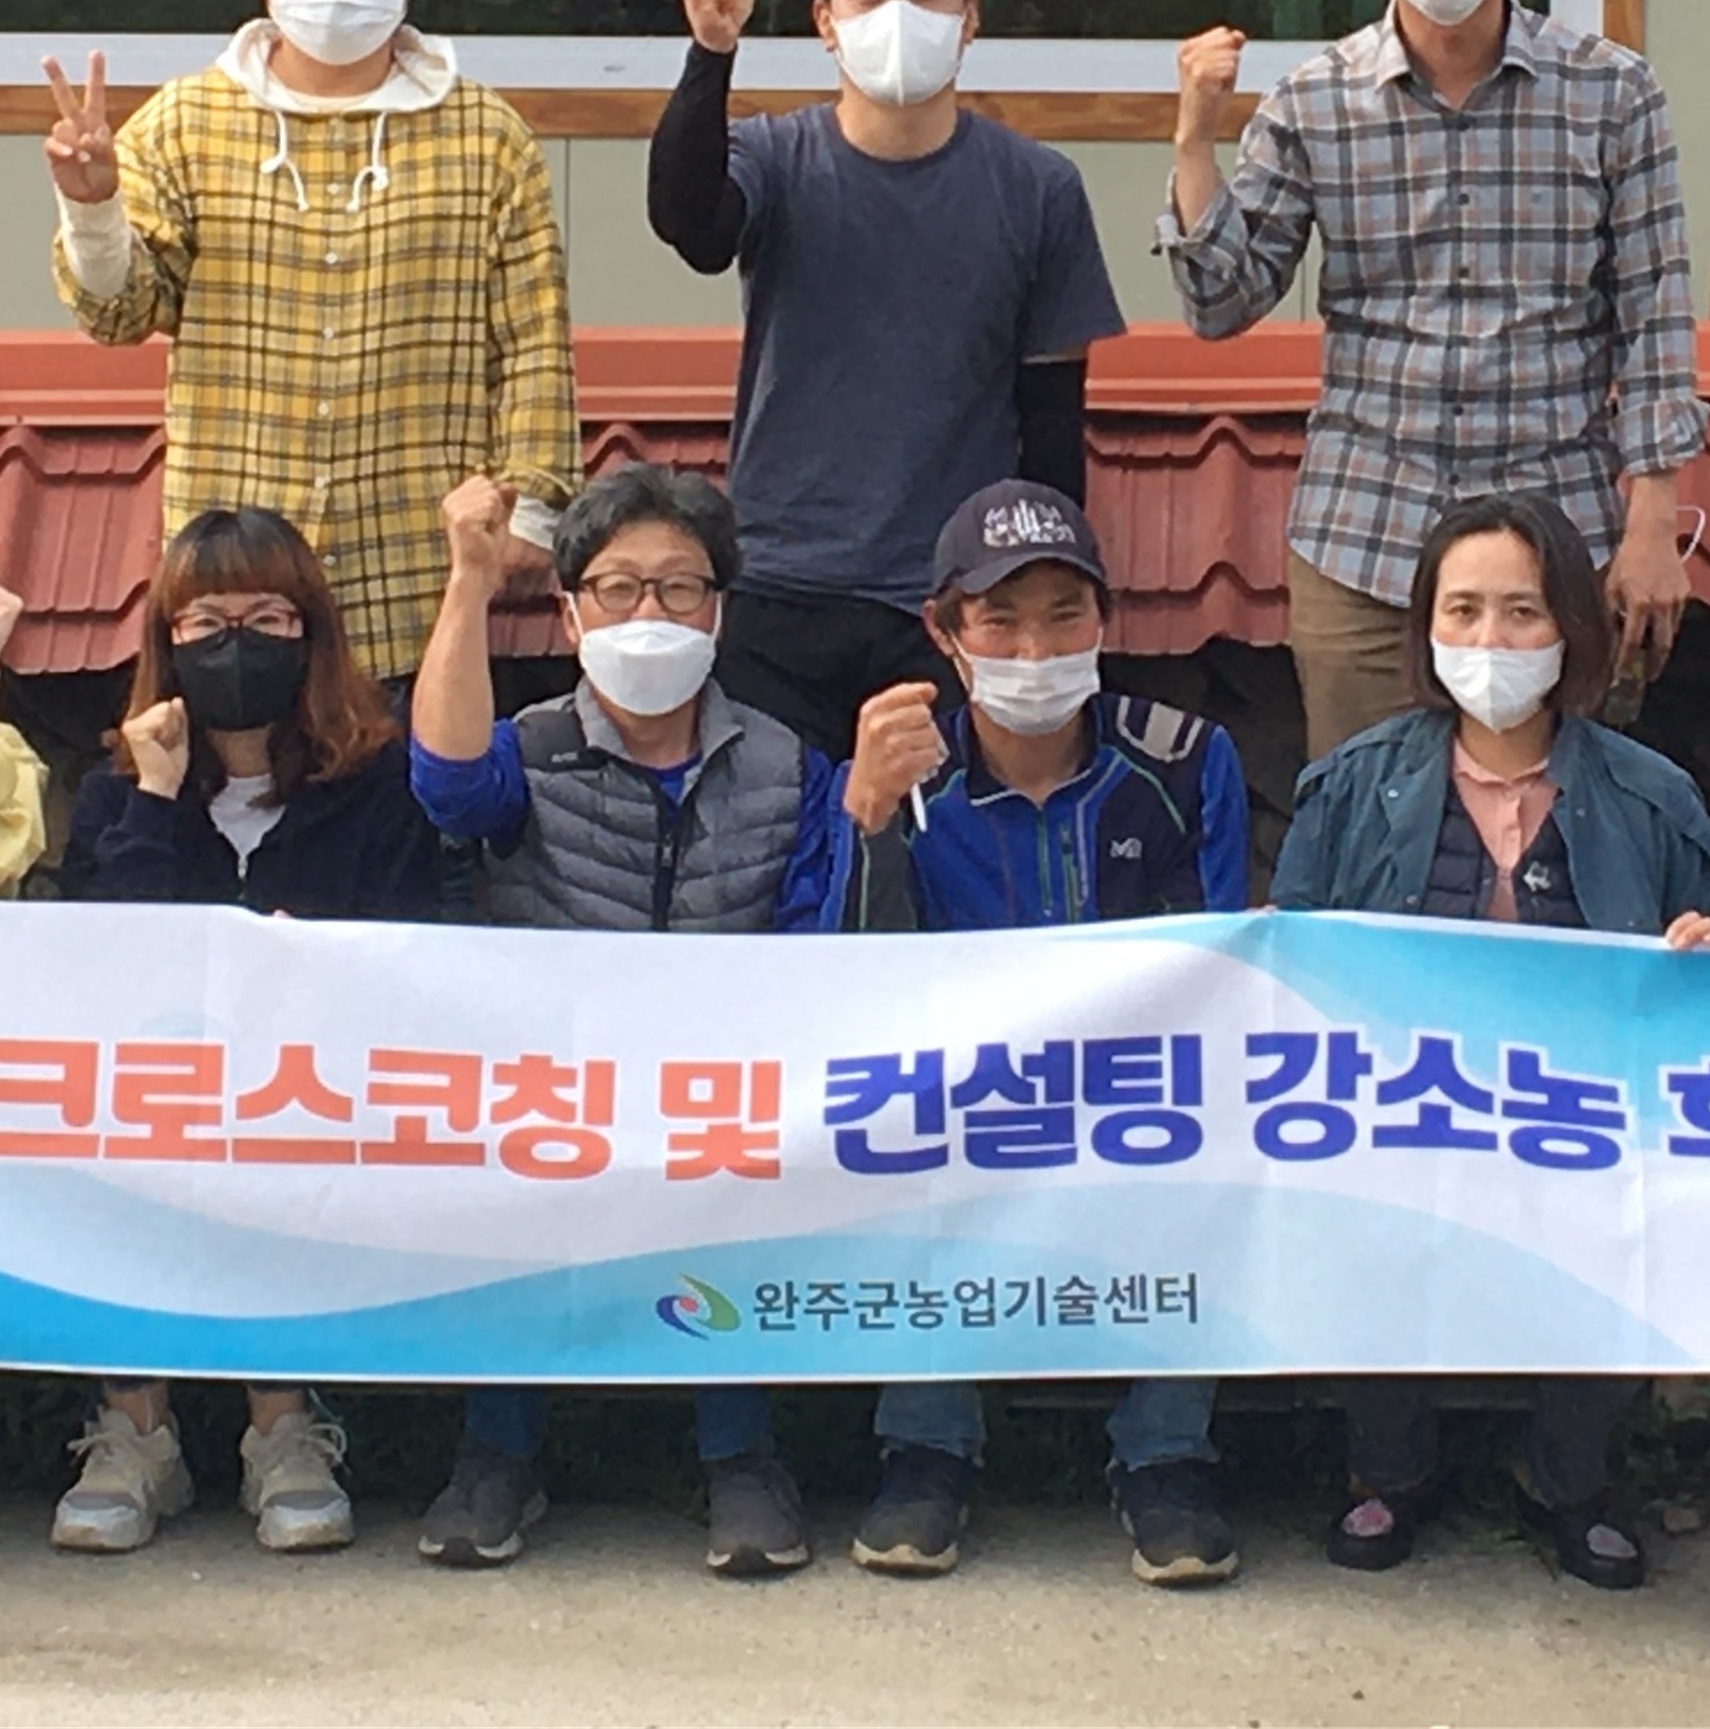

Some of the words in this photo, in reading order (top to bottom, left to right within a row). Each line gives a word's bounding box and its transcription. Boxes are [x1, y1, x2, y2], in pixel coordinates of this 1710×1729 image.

[657, 1058, 783, 1182] 및
[822, 1032, 1204, 1175] 컨설팅
[1245, 1029, 1629, 1172] 강소농
[752, 1272, 1200, 1332] 완주군농업기술센터
